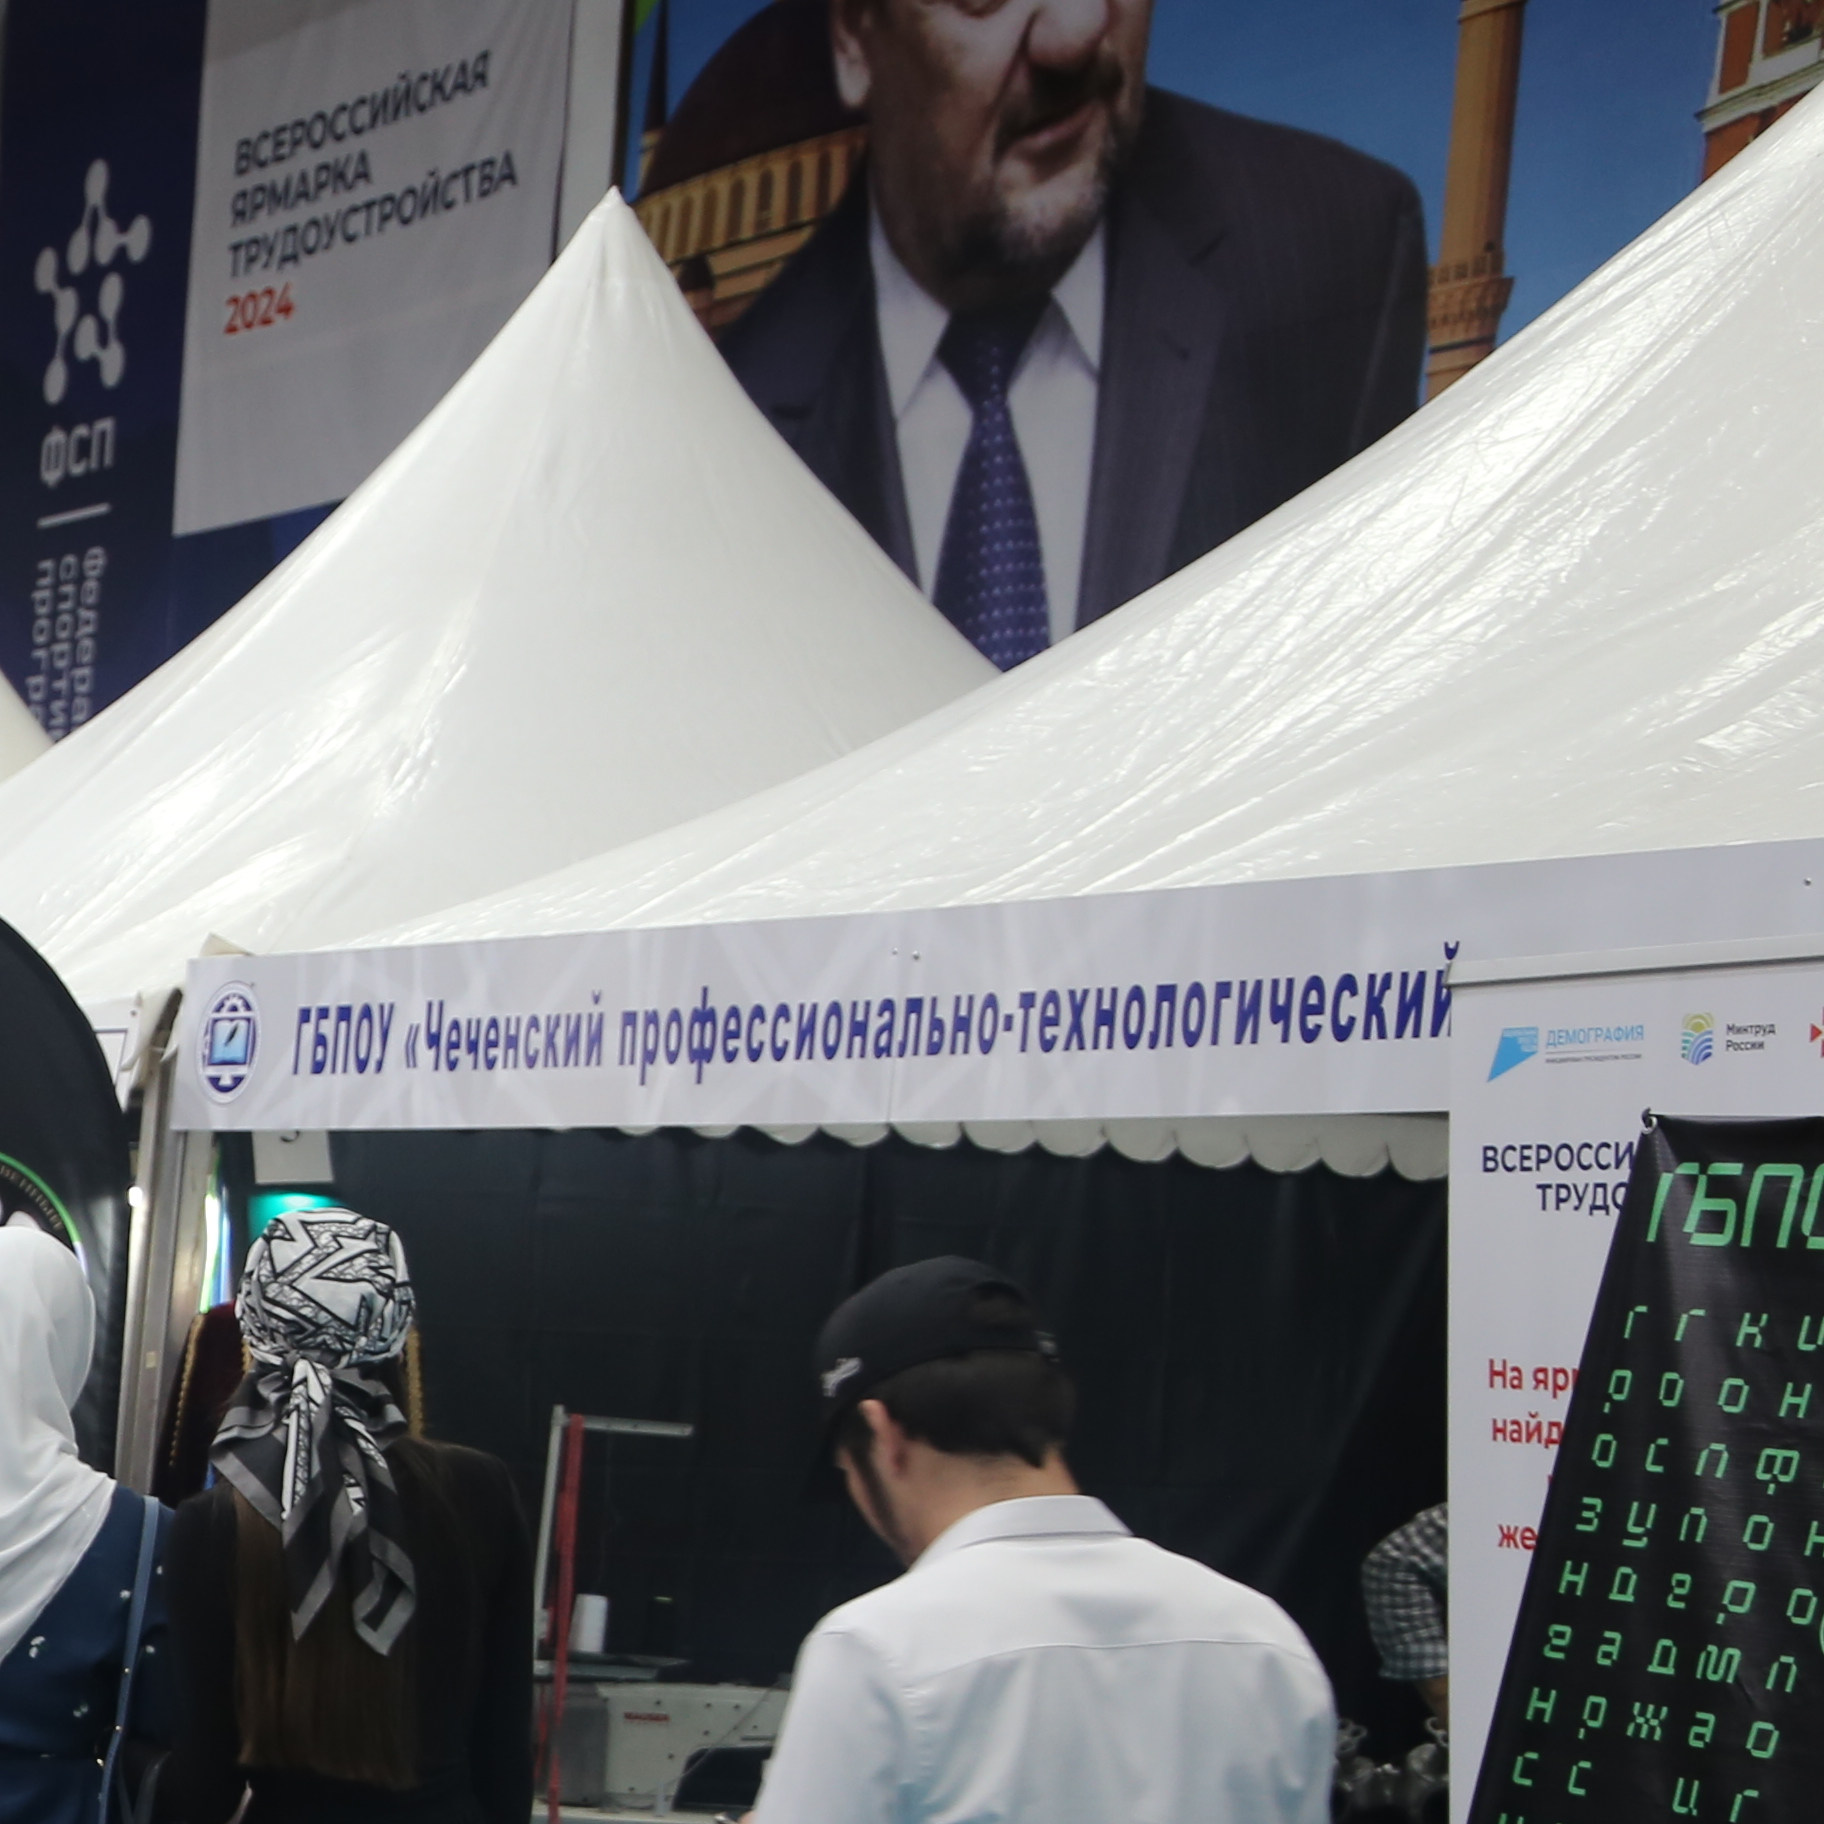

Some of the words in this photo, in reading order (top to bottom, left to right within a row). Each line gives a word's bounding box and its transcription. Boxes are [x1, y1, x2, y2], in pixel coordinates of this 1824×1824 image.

[234, 49, 491, 178] ВСЕРОССИЙСКАЯ
[230, 149, 372, 228] ЯРМАРКА
[228, 150, 519, 278] ТРУДОУСТРОЙСТВА
[223, 281, 295, 335] 2024
[40, 415, 116, 489] ФСП
[25, 559, 55, 724] програ
[292, 1001, 394, 1076] ГБПОУ
[404, 989, 605, 1073] «Чеченский
[618, 940, 1458, 1086] профессионально-технологический
[1726, 1022, 1777, 1039] Минтруд
[1546, 1024, 1645, 1049] ДЕМОГРАФИЯ
[1726, 1038, 1766, 1051] России
[1482, 1141, 1636, 1173] ВСЕРОССИ
[1537, 1182, 1629, 1215] ТРУДО
[1488, 1358, 1523, 1390] На
[1492, 1411, 1564, 1449] найд
[1498, 1524, 1538, 1550] же
